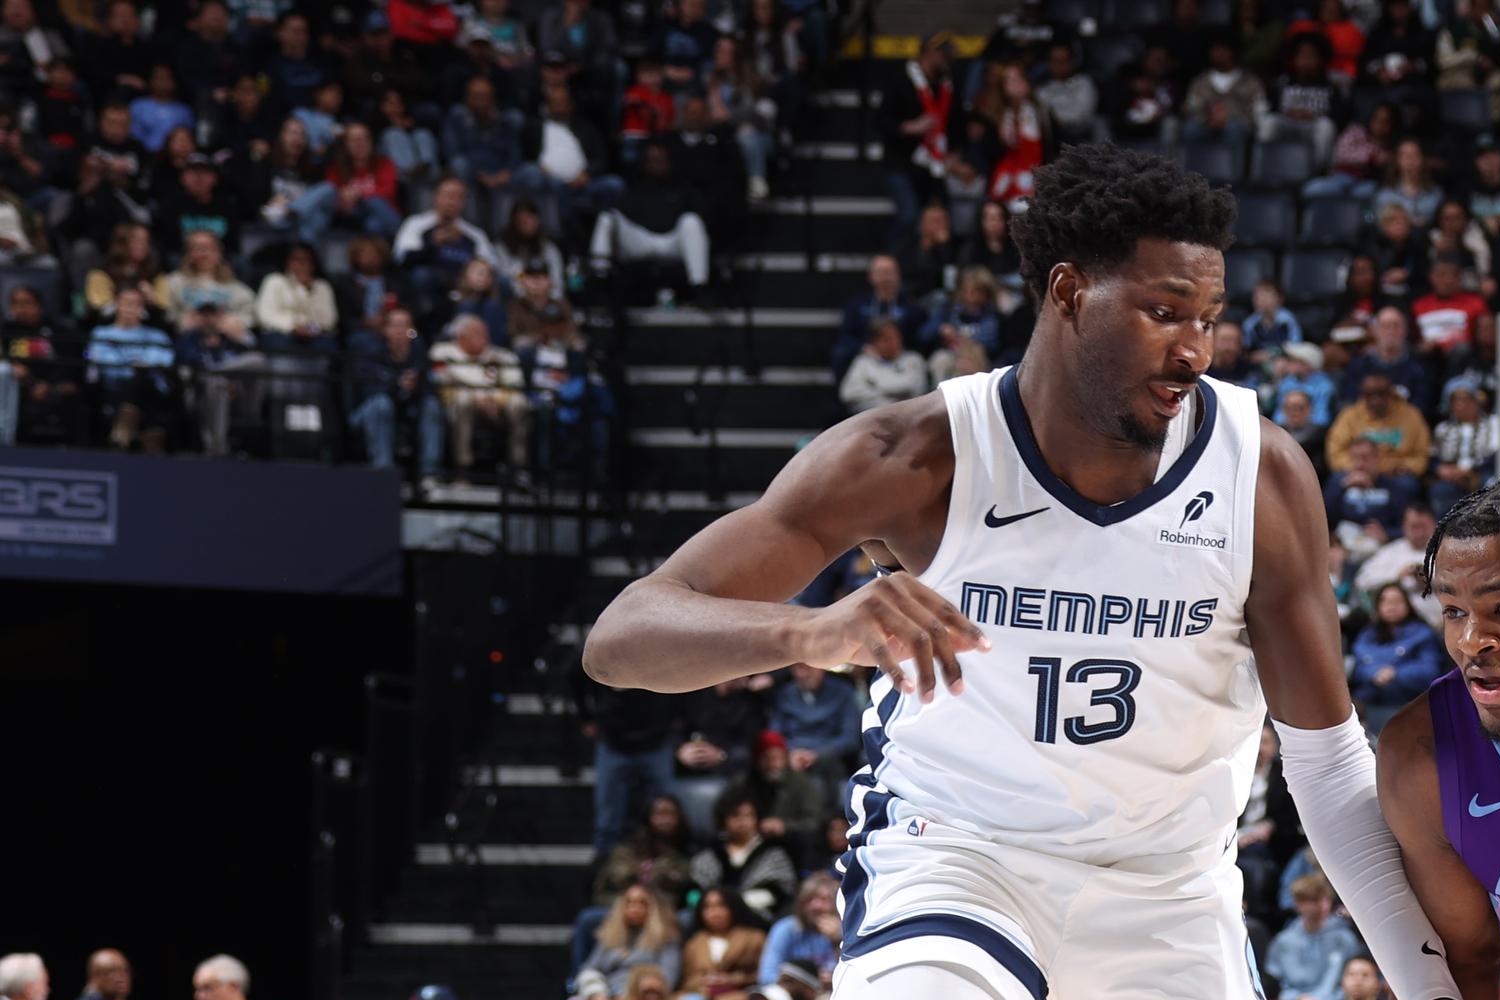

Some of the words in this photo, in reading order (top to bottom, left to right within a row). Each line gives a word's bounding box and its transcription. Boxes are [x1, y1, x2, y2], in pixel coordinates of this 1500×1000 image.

[1160, 530, 1226, 549] Robinhood
[960, 581, 1219, 638] MEMPHIS
[1028, 656, 1142, 746] 13
